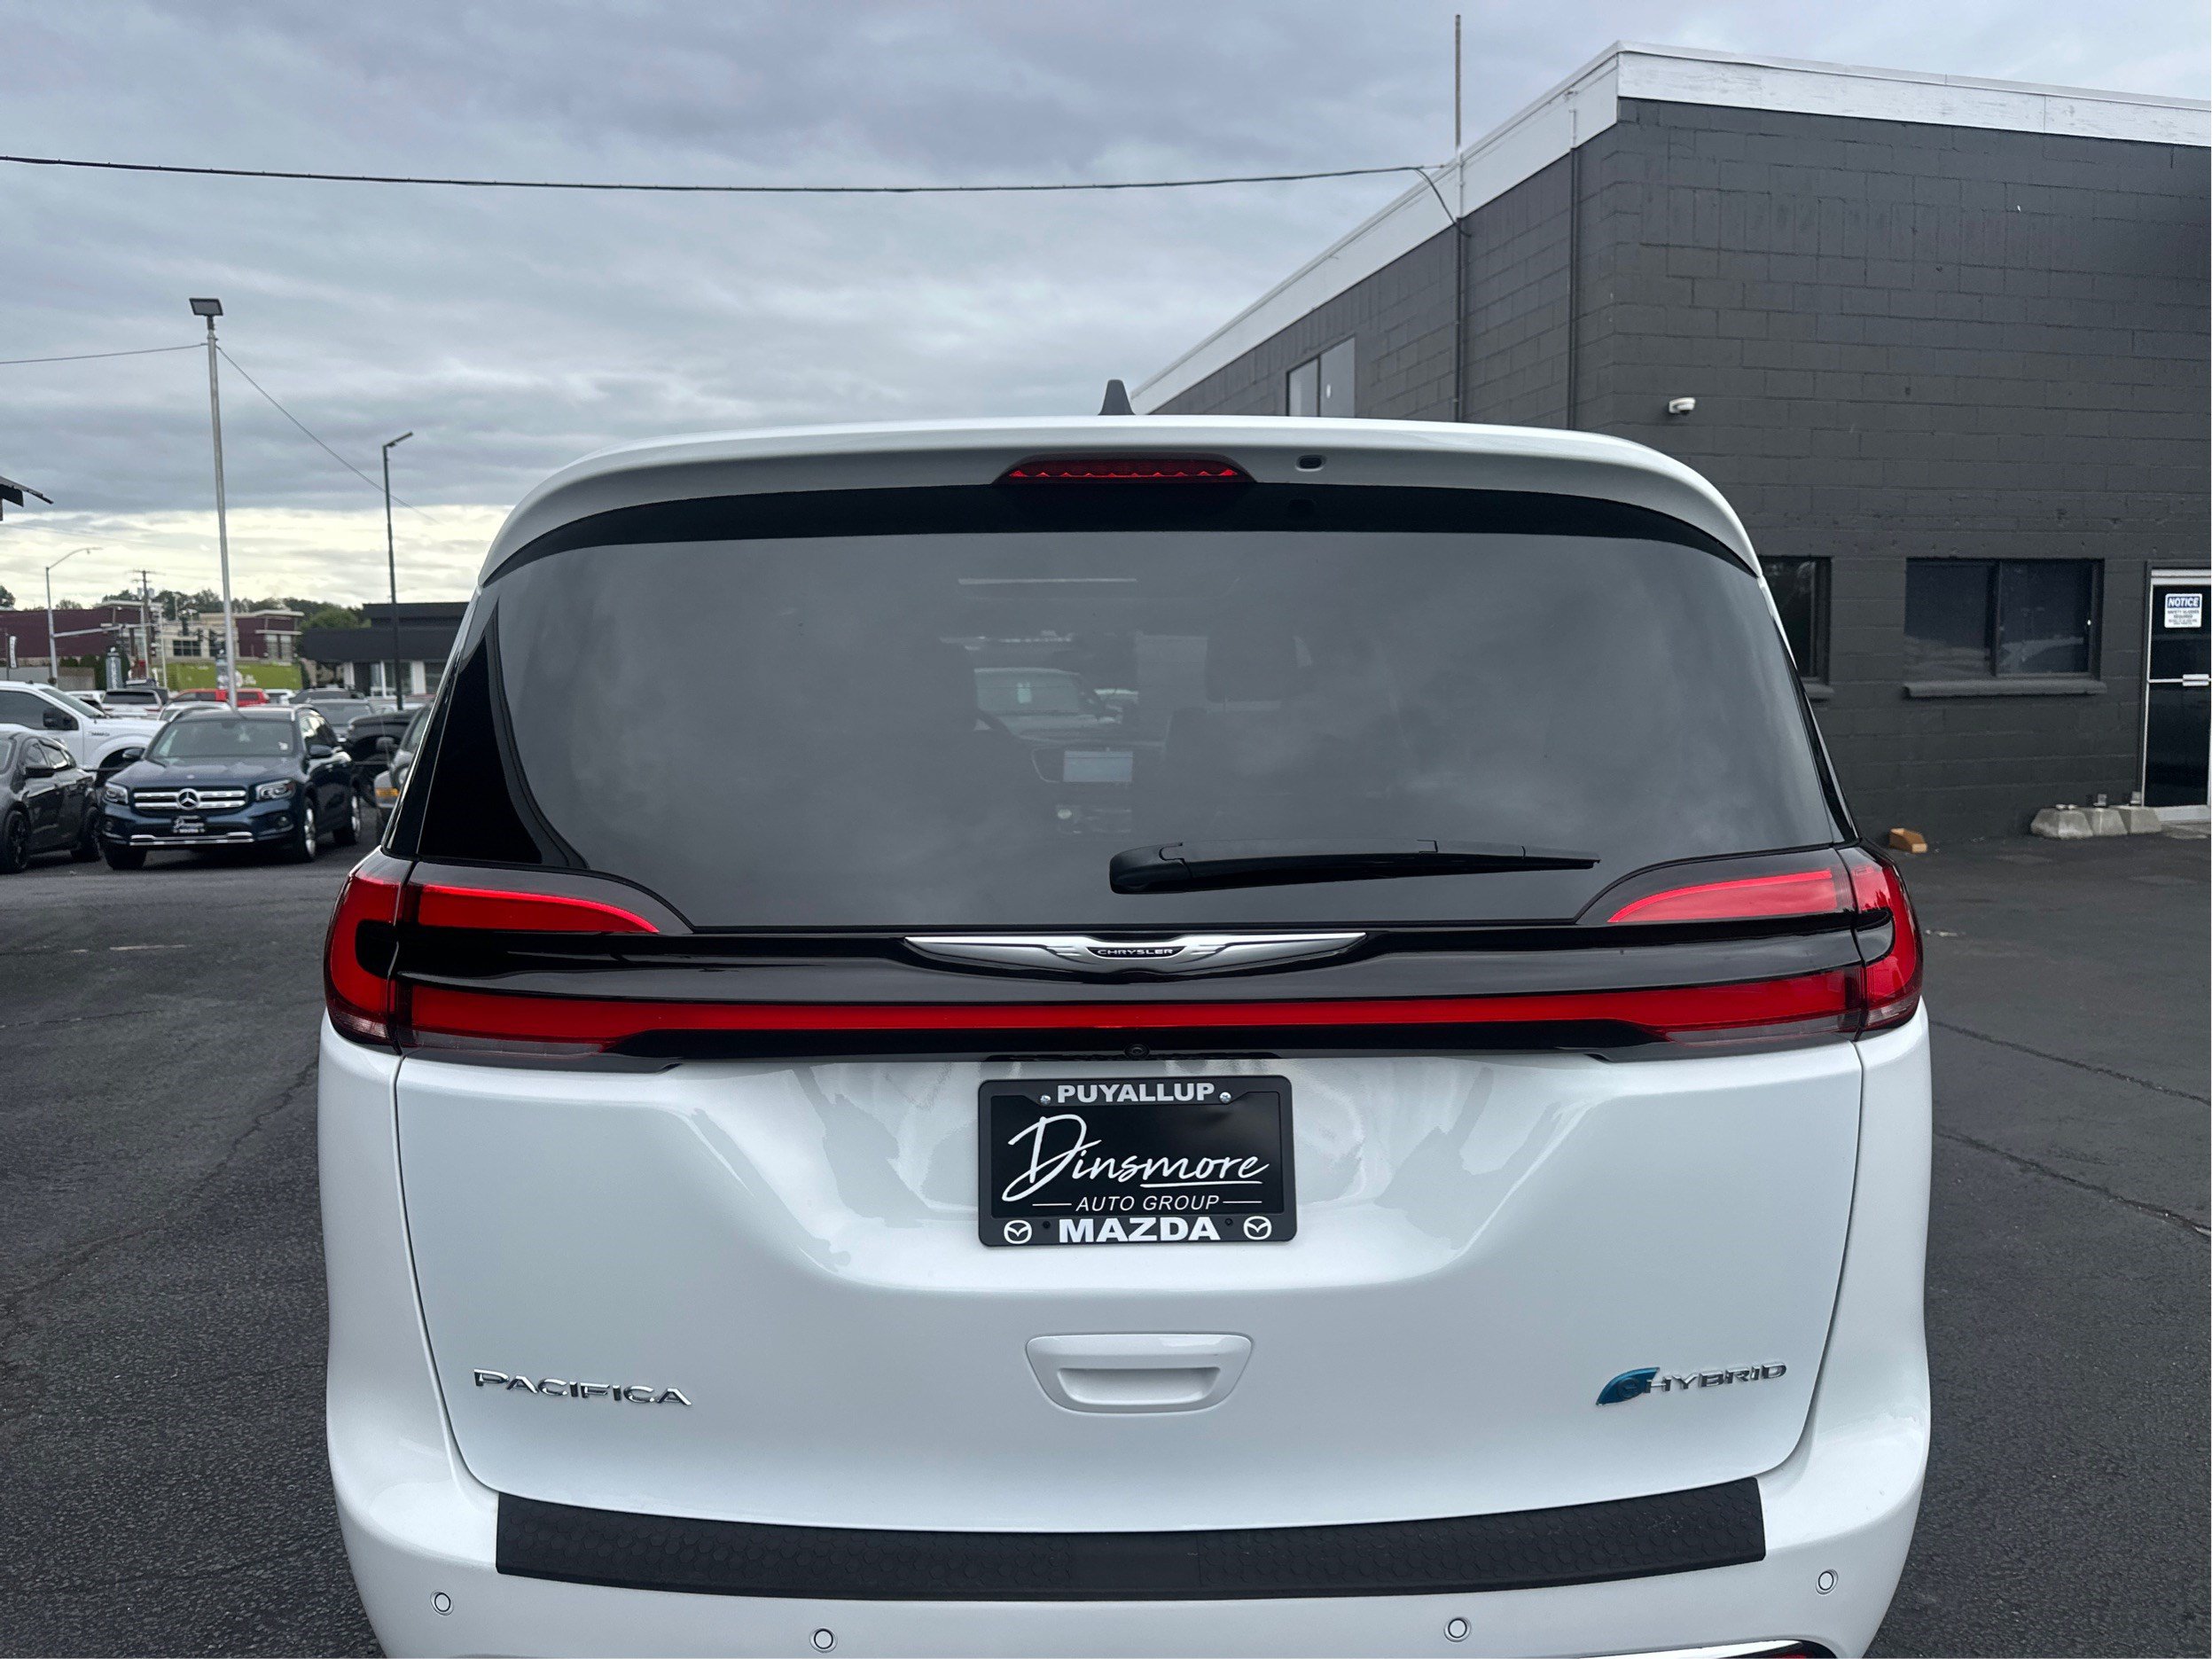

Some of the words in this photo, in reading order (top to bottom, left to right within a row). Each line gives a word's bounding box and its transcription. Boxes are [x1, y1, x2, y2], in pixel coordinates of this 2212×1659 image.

[2168, 597, 2199, 607] NOTICE
[1057, 1083, 1215, 1103] PUYALLUP
[1002, 1114, 1270, 1201] Dinsmore
[1075, 1196, 1135, 1211] AUTO
[1143, 1195, 1220, 1210] GROUP
[1059, 1217, 1221, 1243] MAZDA
[473, 1368, 692, 1406] PACIFICA
